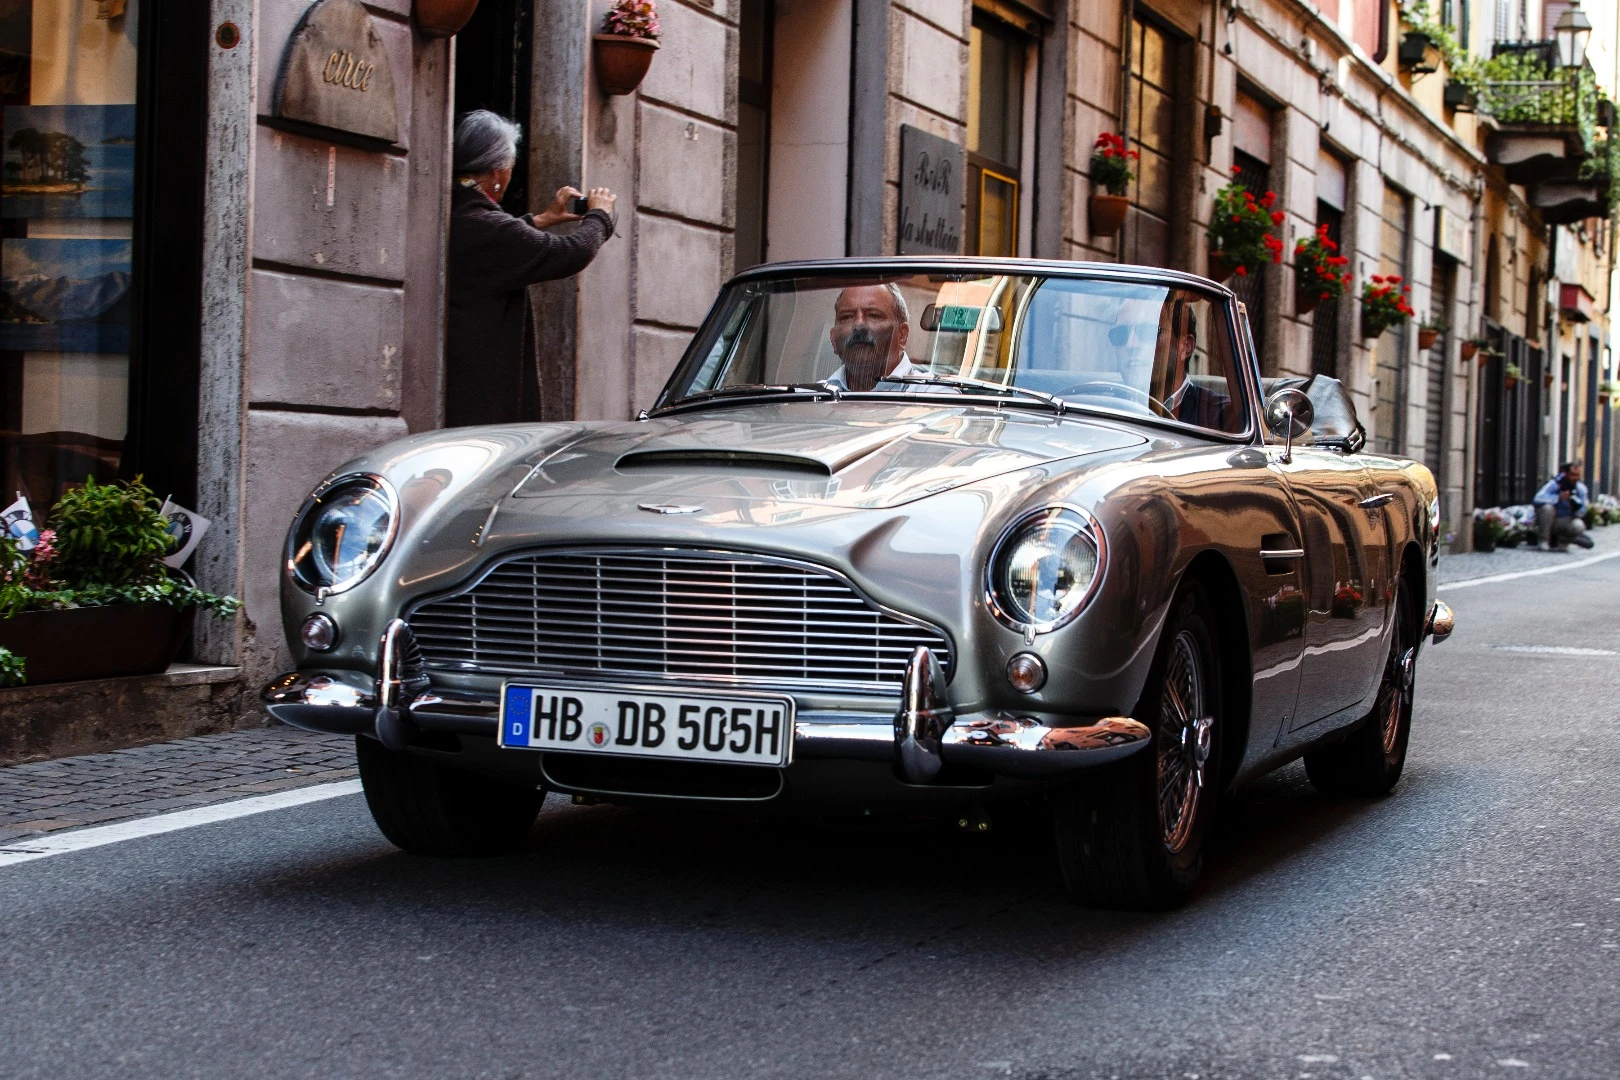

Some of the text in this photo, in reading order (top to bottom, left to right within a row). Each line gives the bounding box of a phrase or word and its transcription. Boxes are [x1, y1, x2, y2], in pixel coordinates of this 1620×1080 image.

[512, 722, 523, 736] D
[533, 694, 781, 755] HB DB 505H
